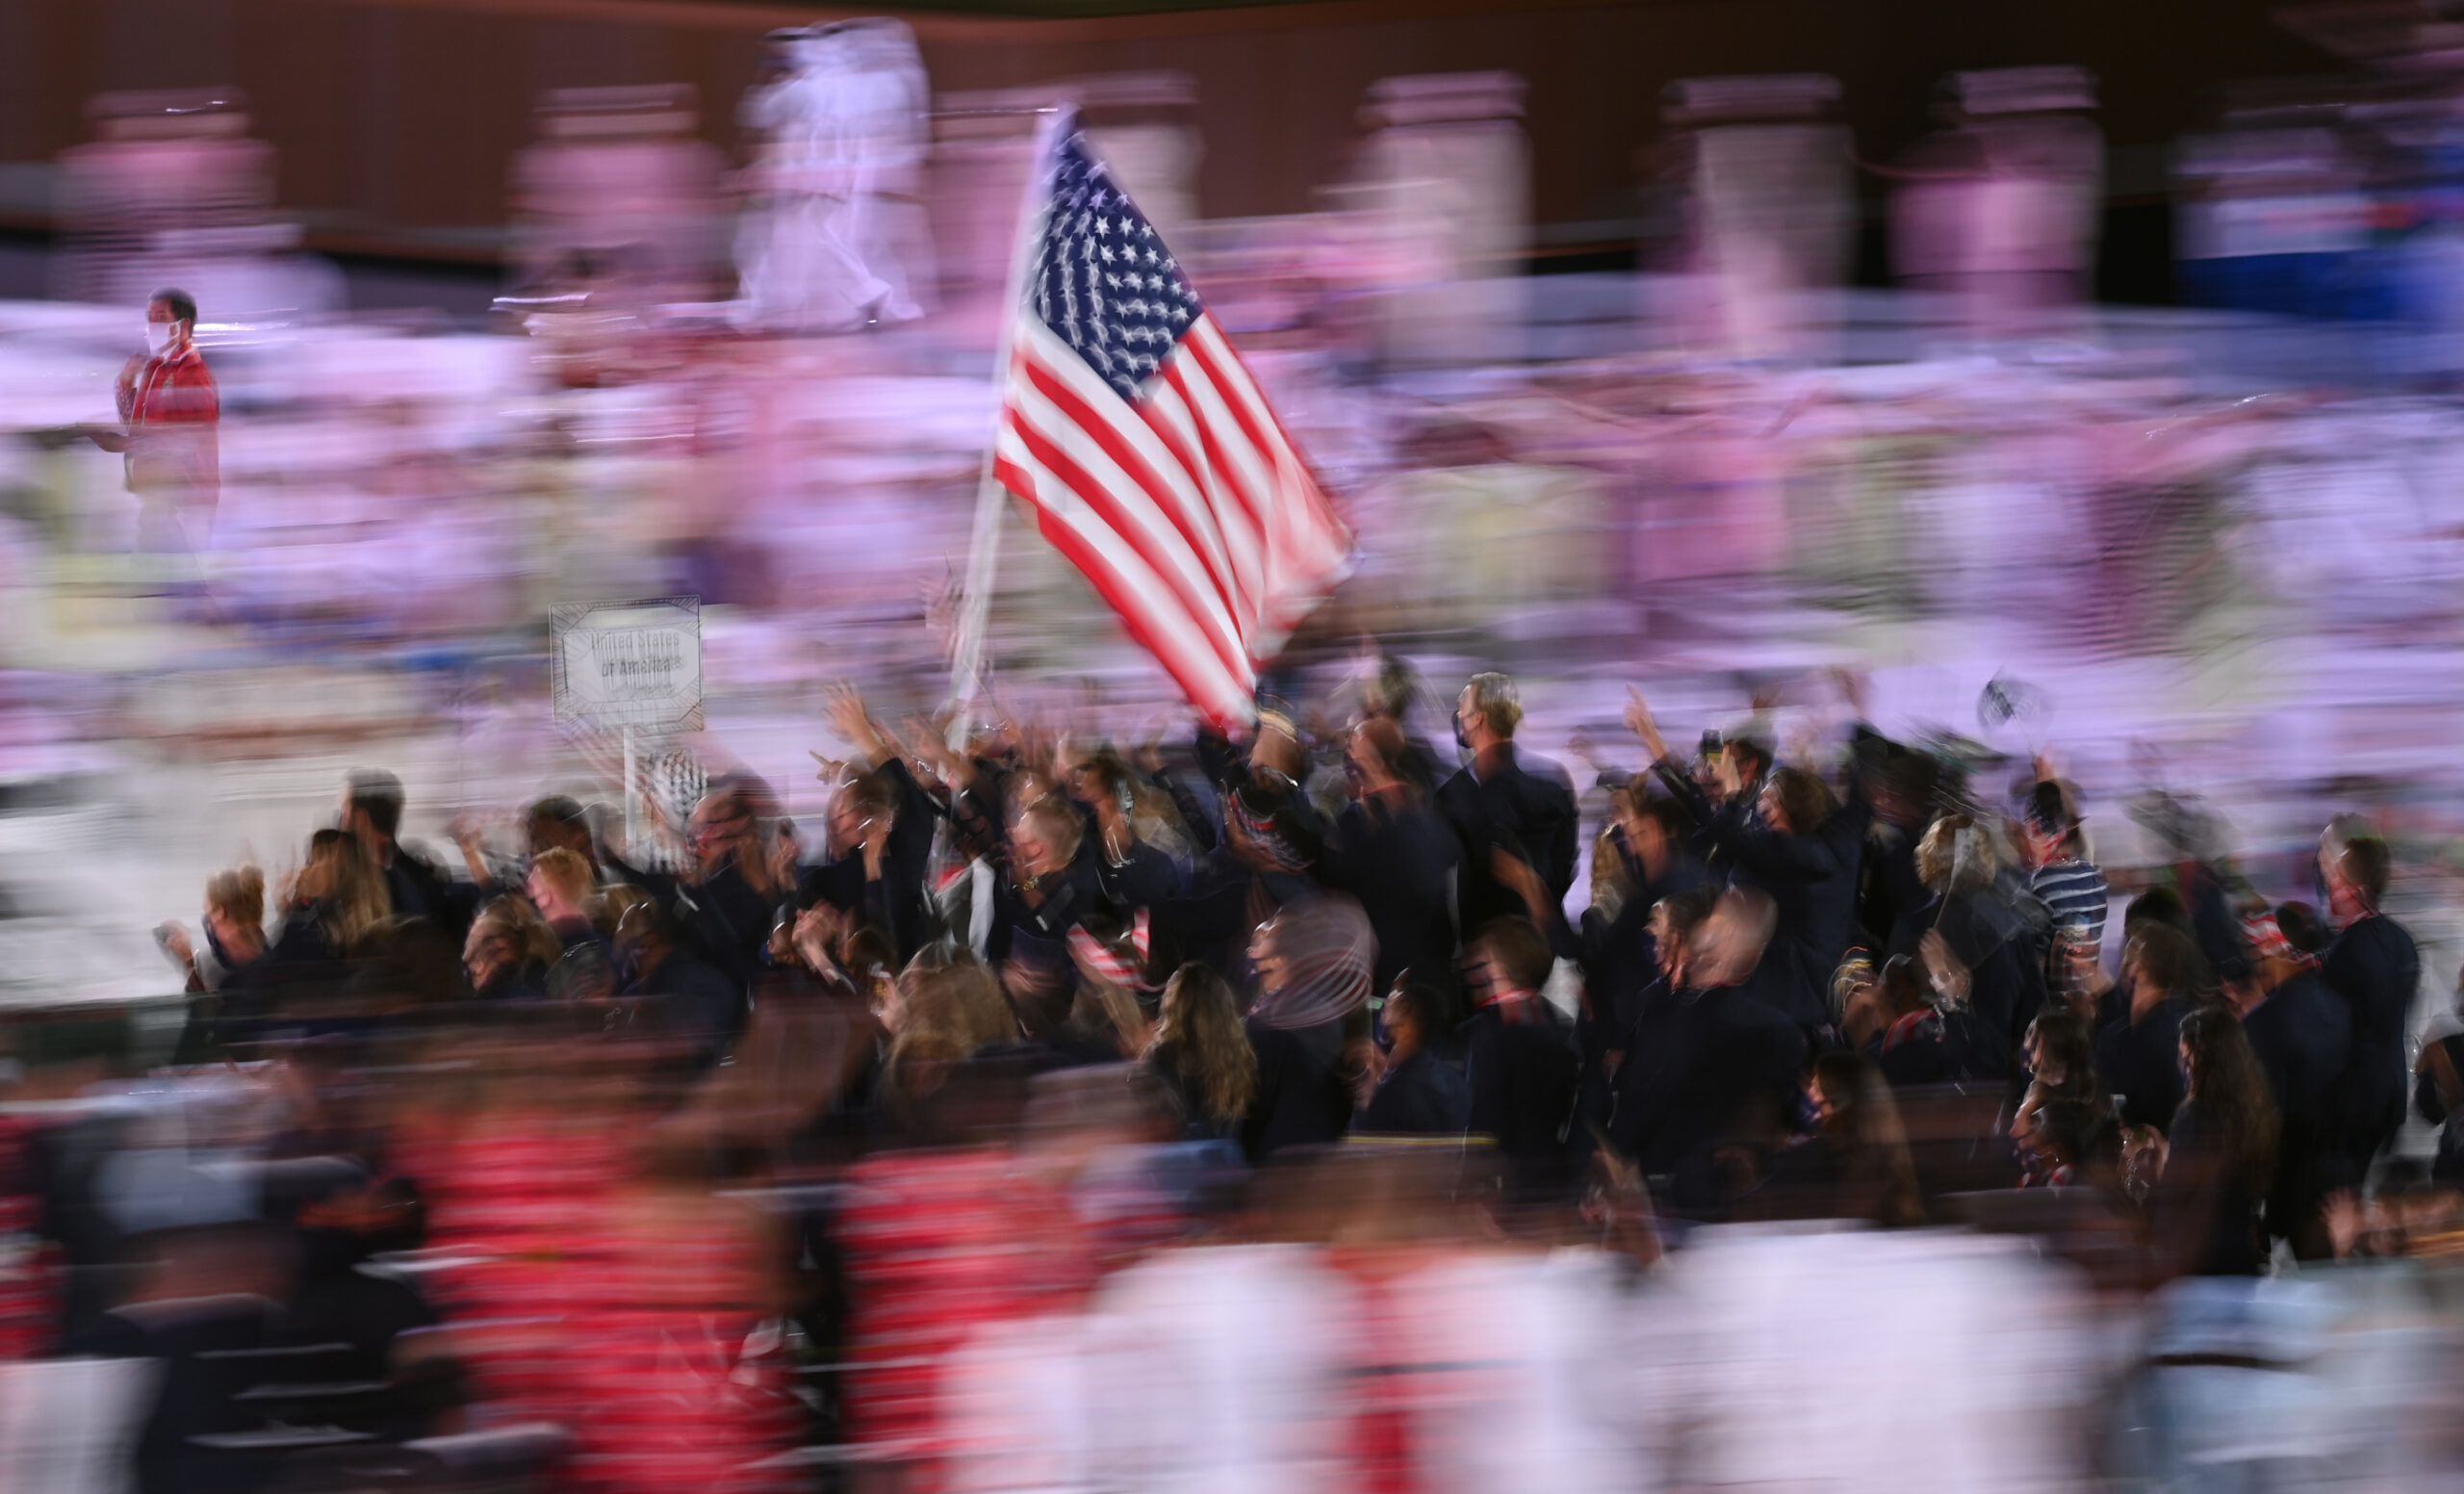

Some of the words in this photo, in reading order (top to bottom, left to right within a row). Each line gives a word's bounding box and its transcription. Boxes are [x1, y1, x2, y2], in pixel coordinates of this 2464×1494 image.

[591, 631, 633, 649] United
[637, 630, 680, 648] States
[602, 660, 615, 677] of
[619, 657, 671, 676] America
